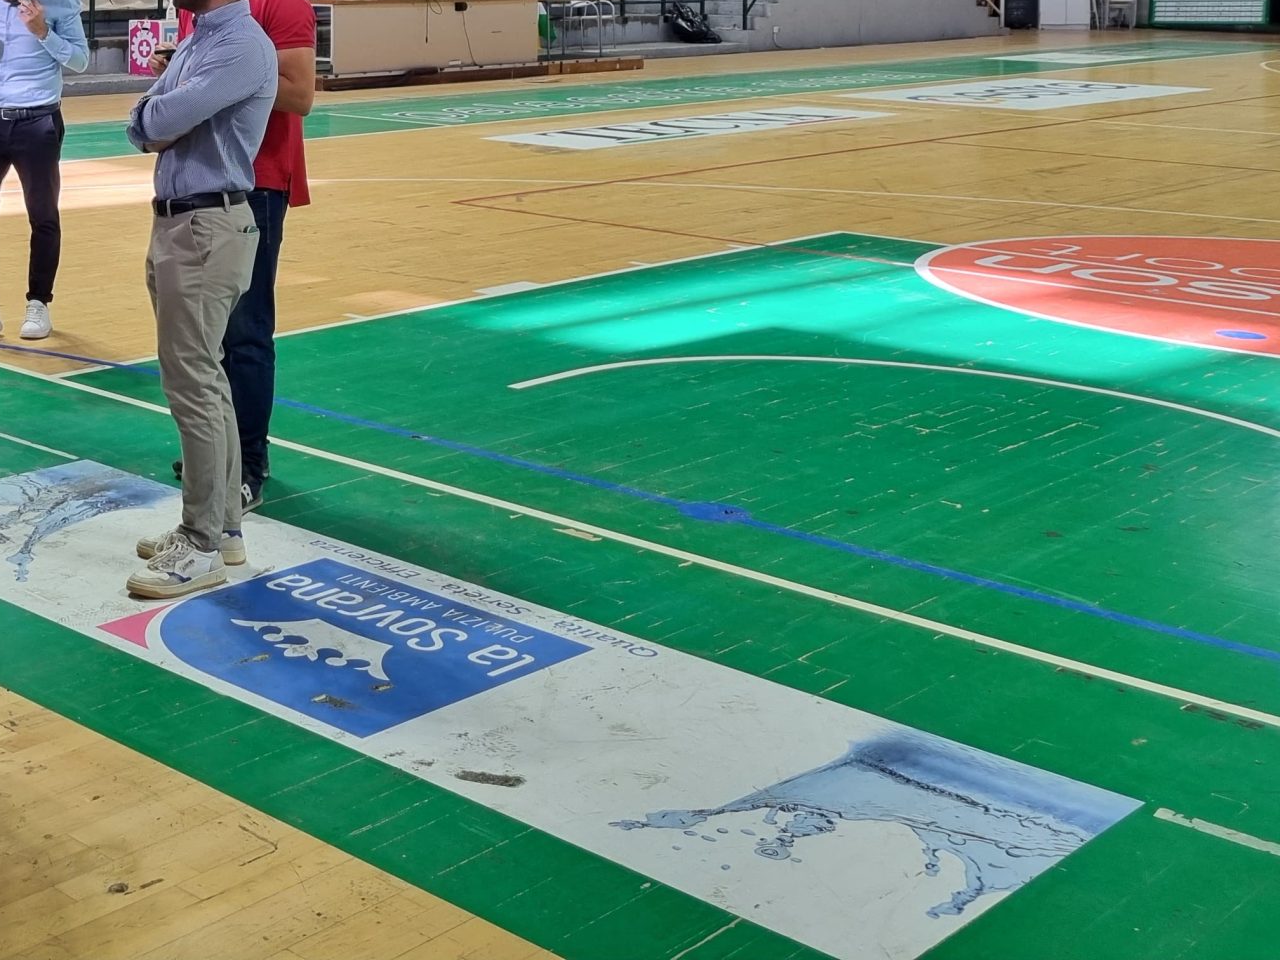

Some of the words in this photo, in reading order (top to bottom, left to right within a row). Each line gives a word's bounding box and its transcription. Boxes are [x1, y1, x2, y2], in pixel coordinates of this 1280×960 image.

[535, 111, 841, 141] TECNA
[308, 539, 422, 581] Efficienza
[335, 573, 443, 612] AMBIENTI
[440, 582, 532, 617] Serietà
[263, 571, 470, 653] Sovrana
[443, 607, 535, 645] PULIZIA
[552, 619, 659, 659] Qualità
[466, 643, 536, 677] la
